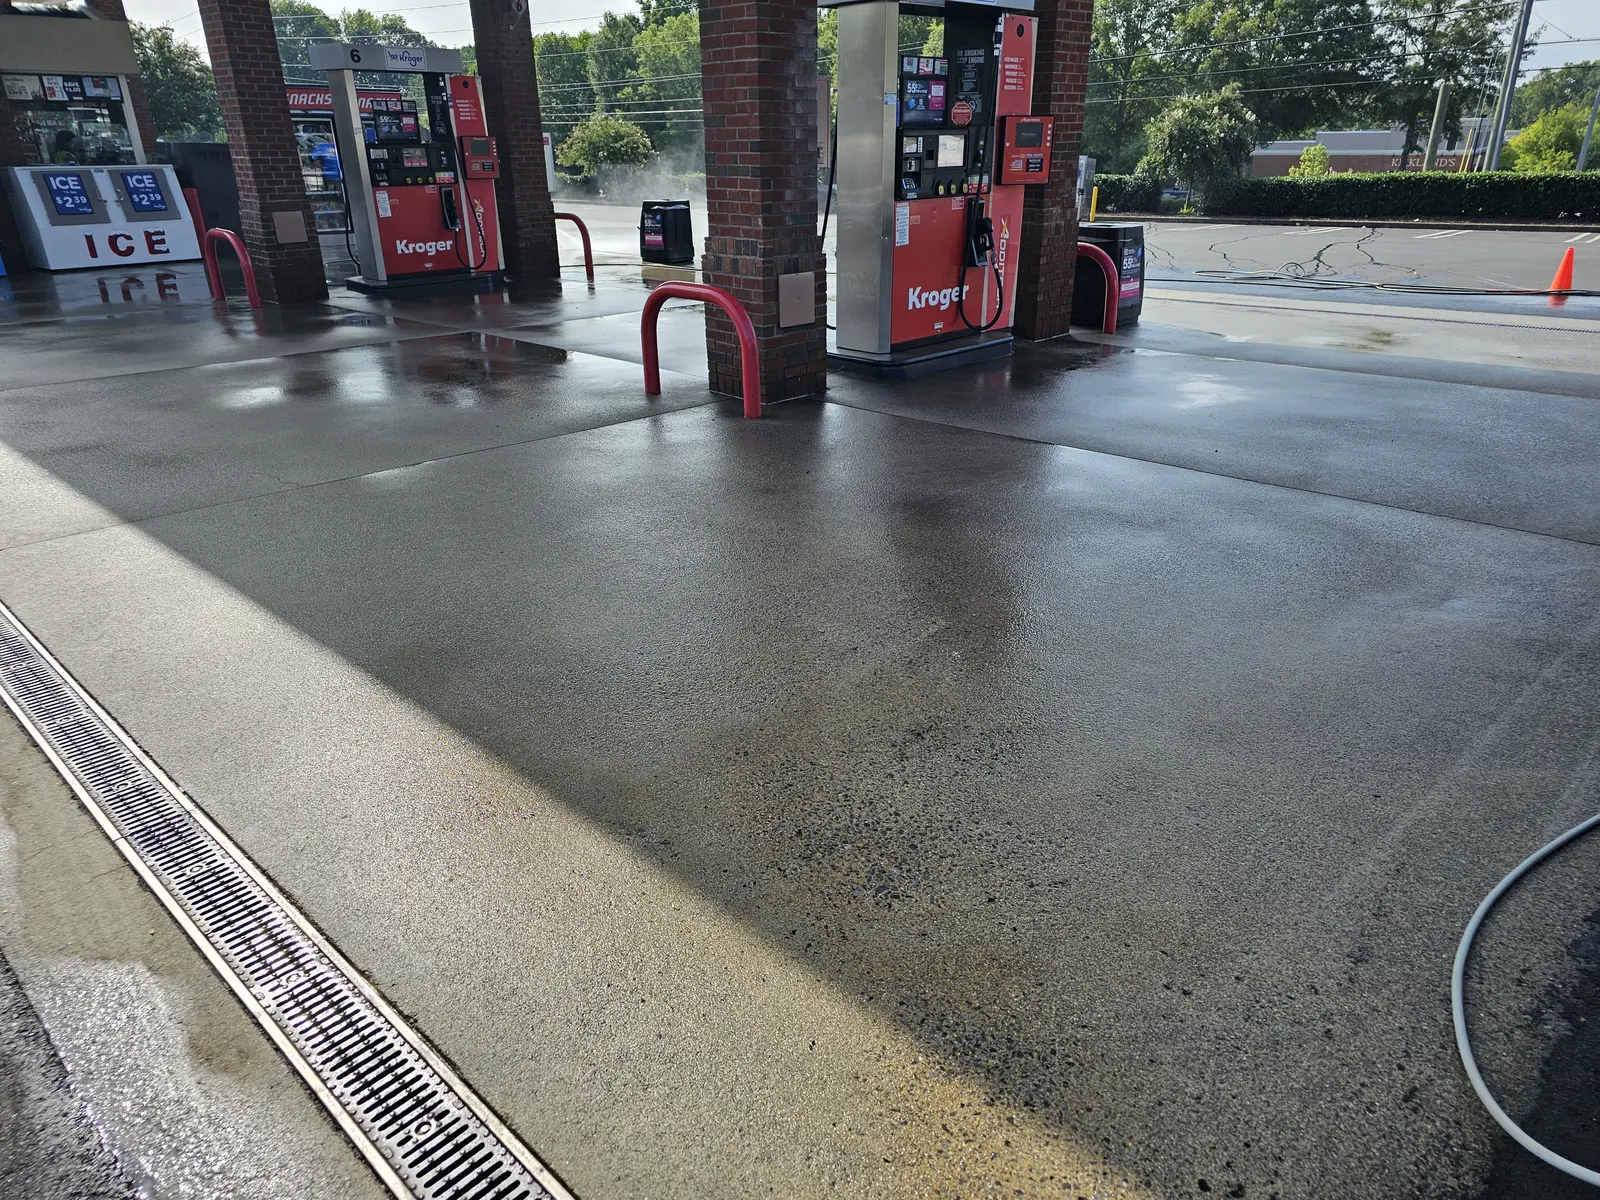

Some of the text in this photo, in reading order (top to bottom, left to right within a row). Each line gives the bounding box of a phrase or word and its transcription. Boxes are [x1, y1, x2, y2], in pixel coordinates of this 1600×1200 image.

[350, 49, 361, 63] 6
[400, 50, 423, 67] Kroger
[1391, 158, 1456, 167] KIKLND'S
[50, 176, 81, 190] ICE
[126, 174, 156, 188] ICE
[83, 226, 171, 259] ICE
[395, 239, 453, 256] Kroger
[908, 284, 969, 311] Kroger
